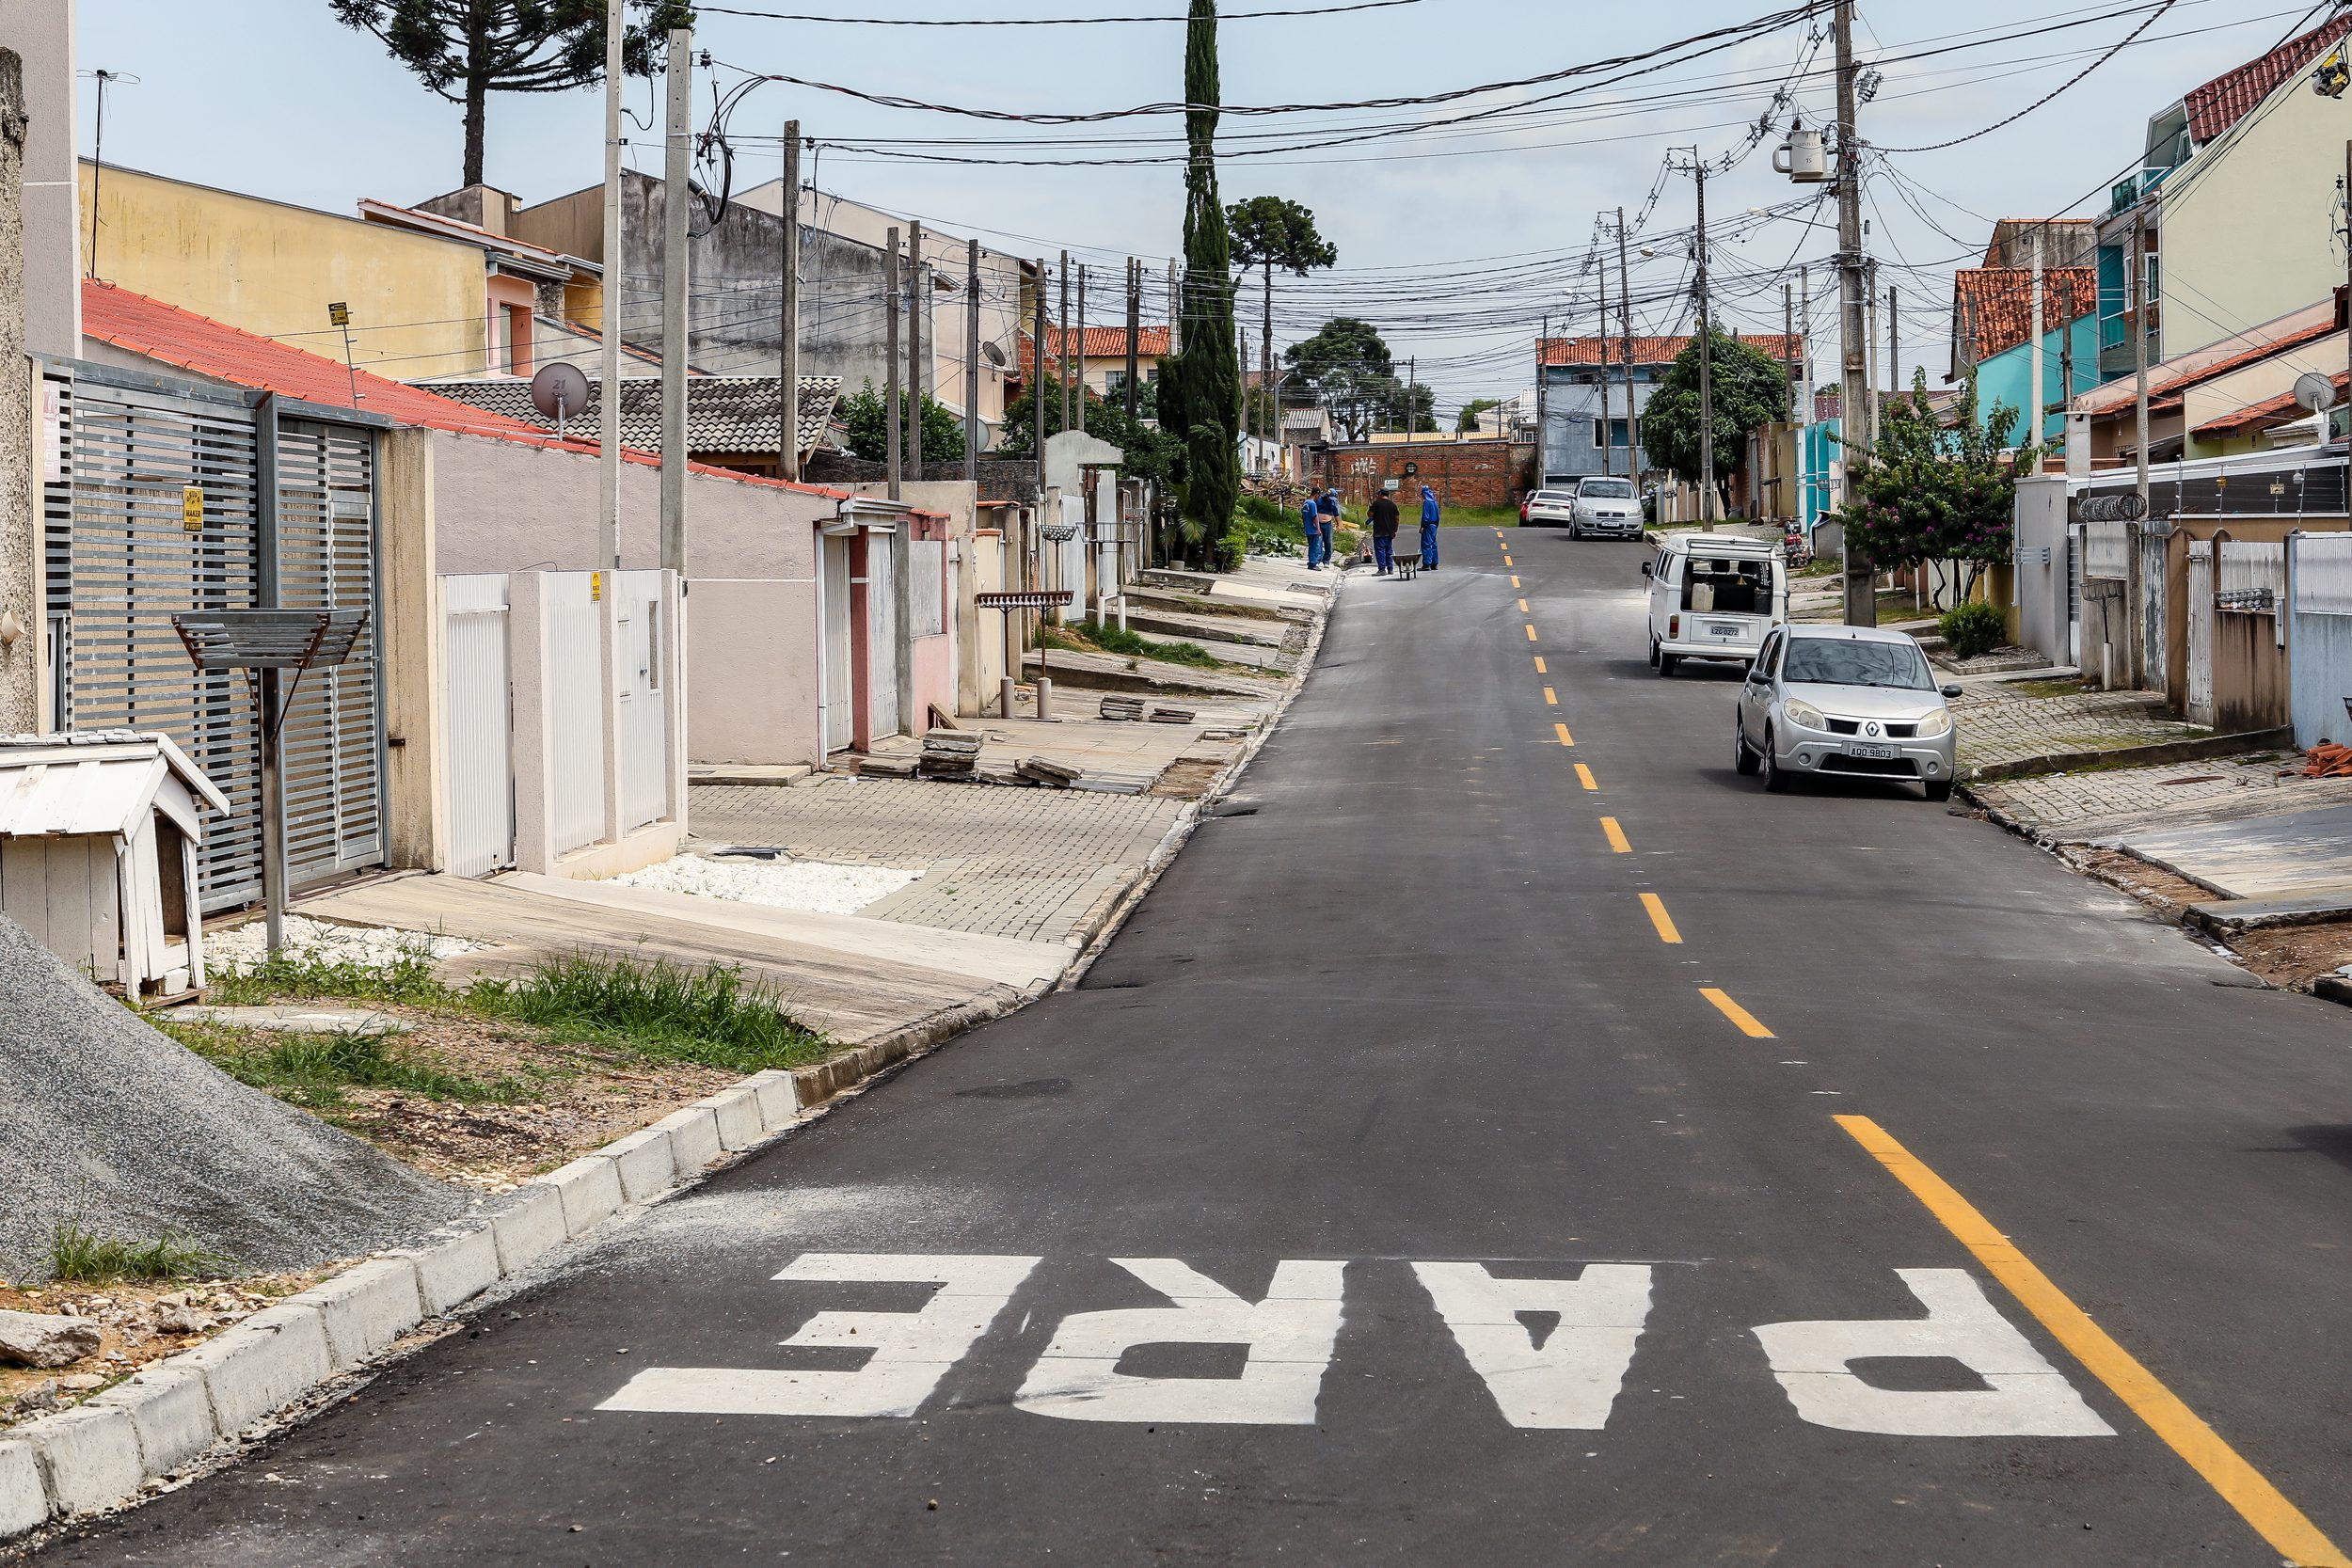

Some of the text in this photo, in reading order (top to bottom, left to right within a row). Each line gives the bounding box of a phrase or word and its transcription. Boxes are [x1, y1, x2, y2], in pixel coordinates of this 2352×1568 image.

[552, 379, 566, 389] 21
[186, 509, 200, 517] MAKER
[594, 1254, 2118, 1437] PARE
